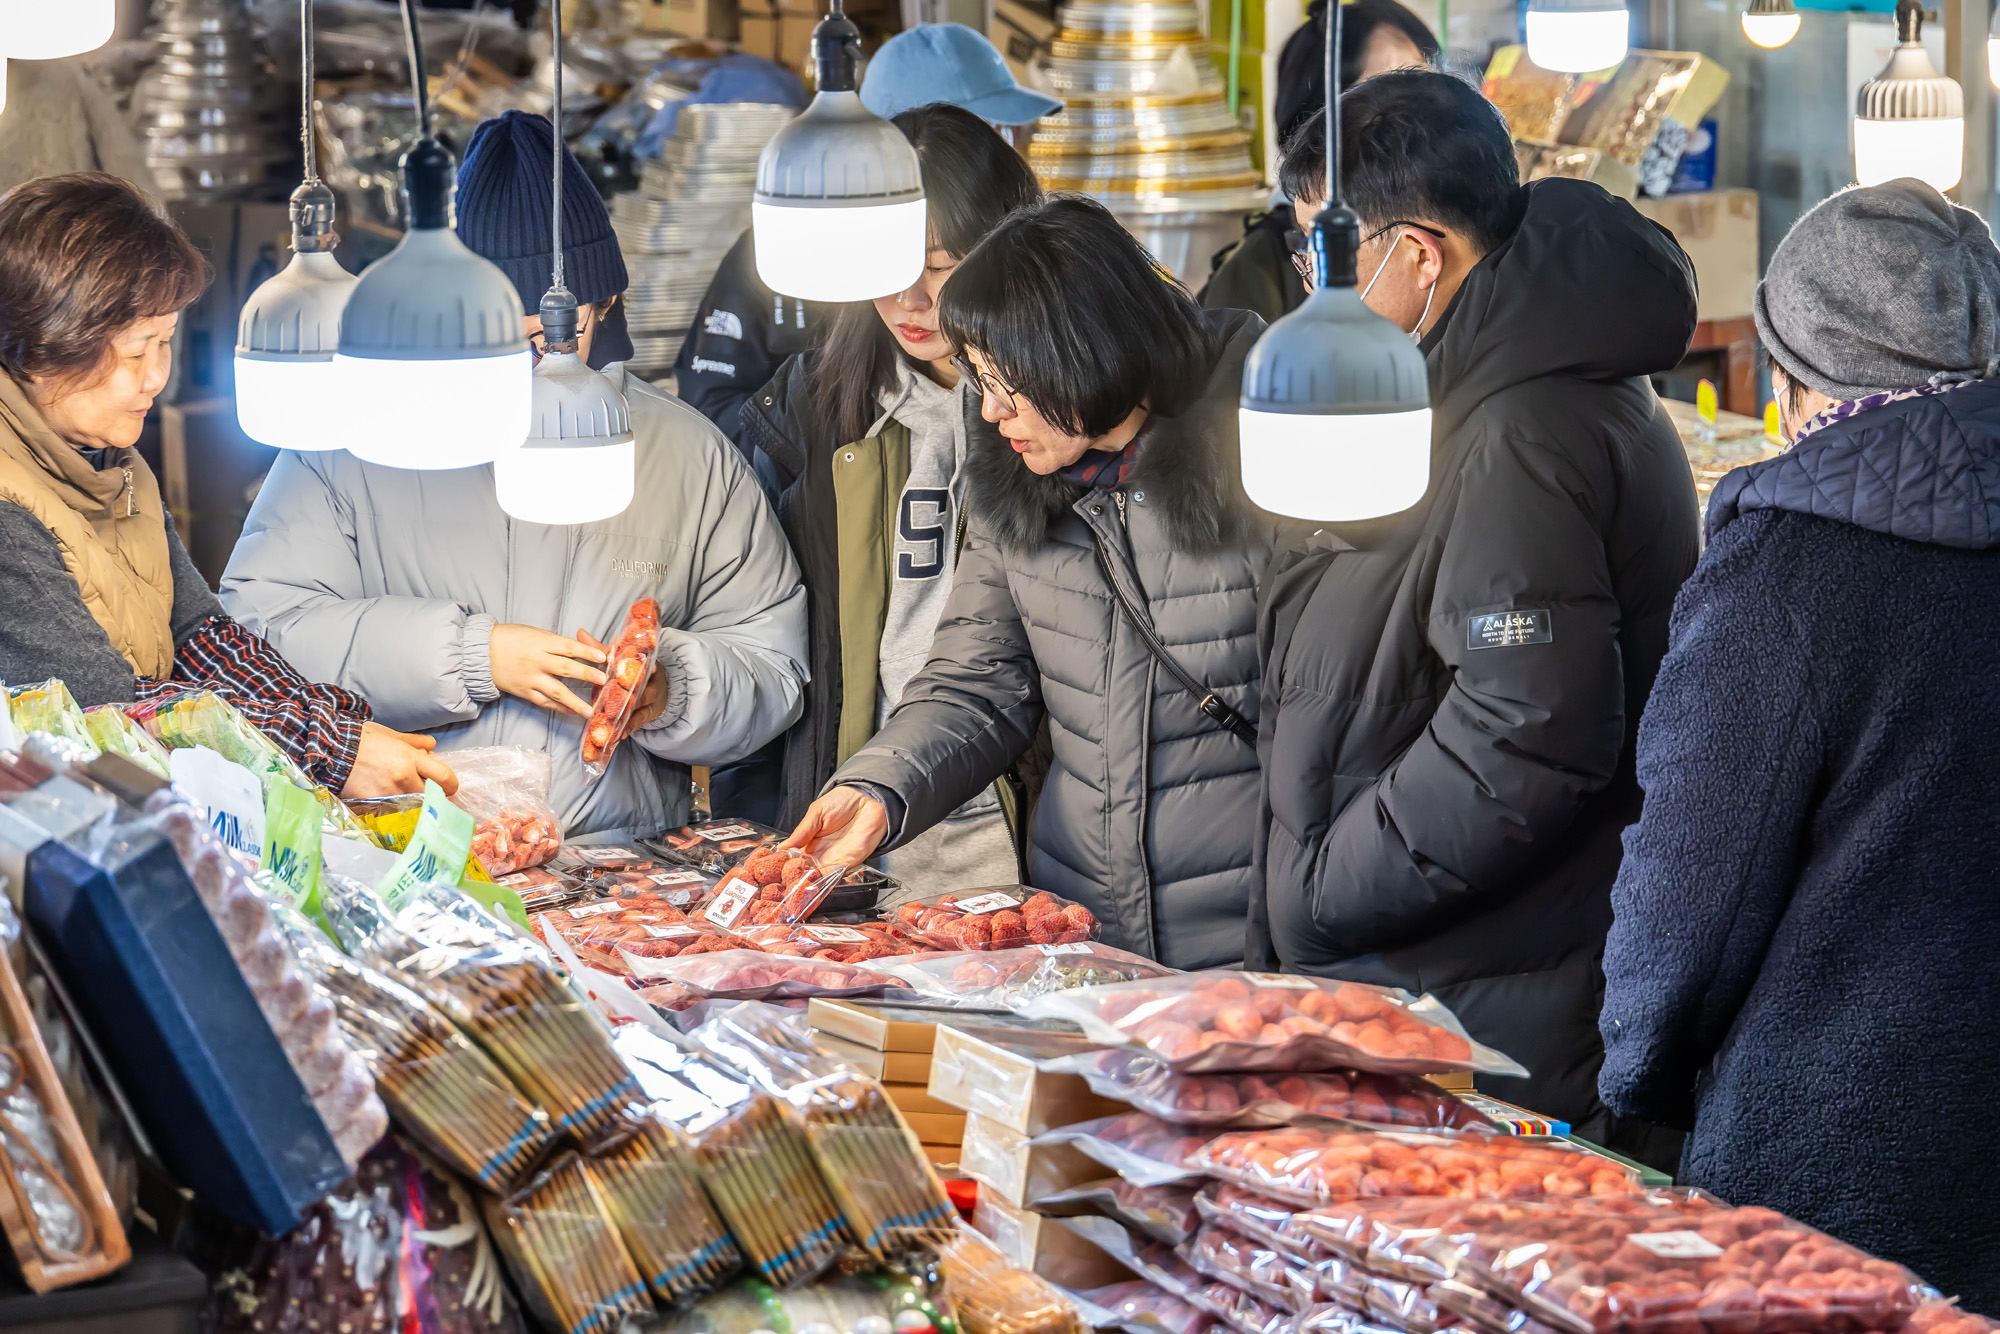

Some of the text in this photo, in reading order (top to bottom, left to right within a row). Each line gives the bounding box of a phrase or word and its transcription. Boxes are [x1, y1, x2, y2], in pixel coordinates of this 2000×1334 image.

[897, 487, 948, 580] S
[611, 558, 668, 577] CALIFORNIA
[1493, 617, 1533, 628] ALASKA
